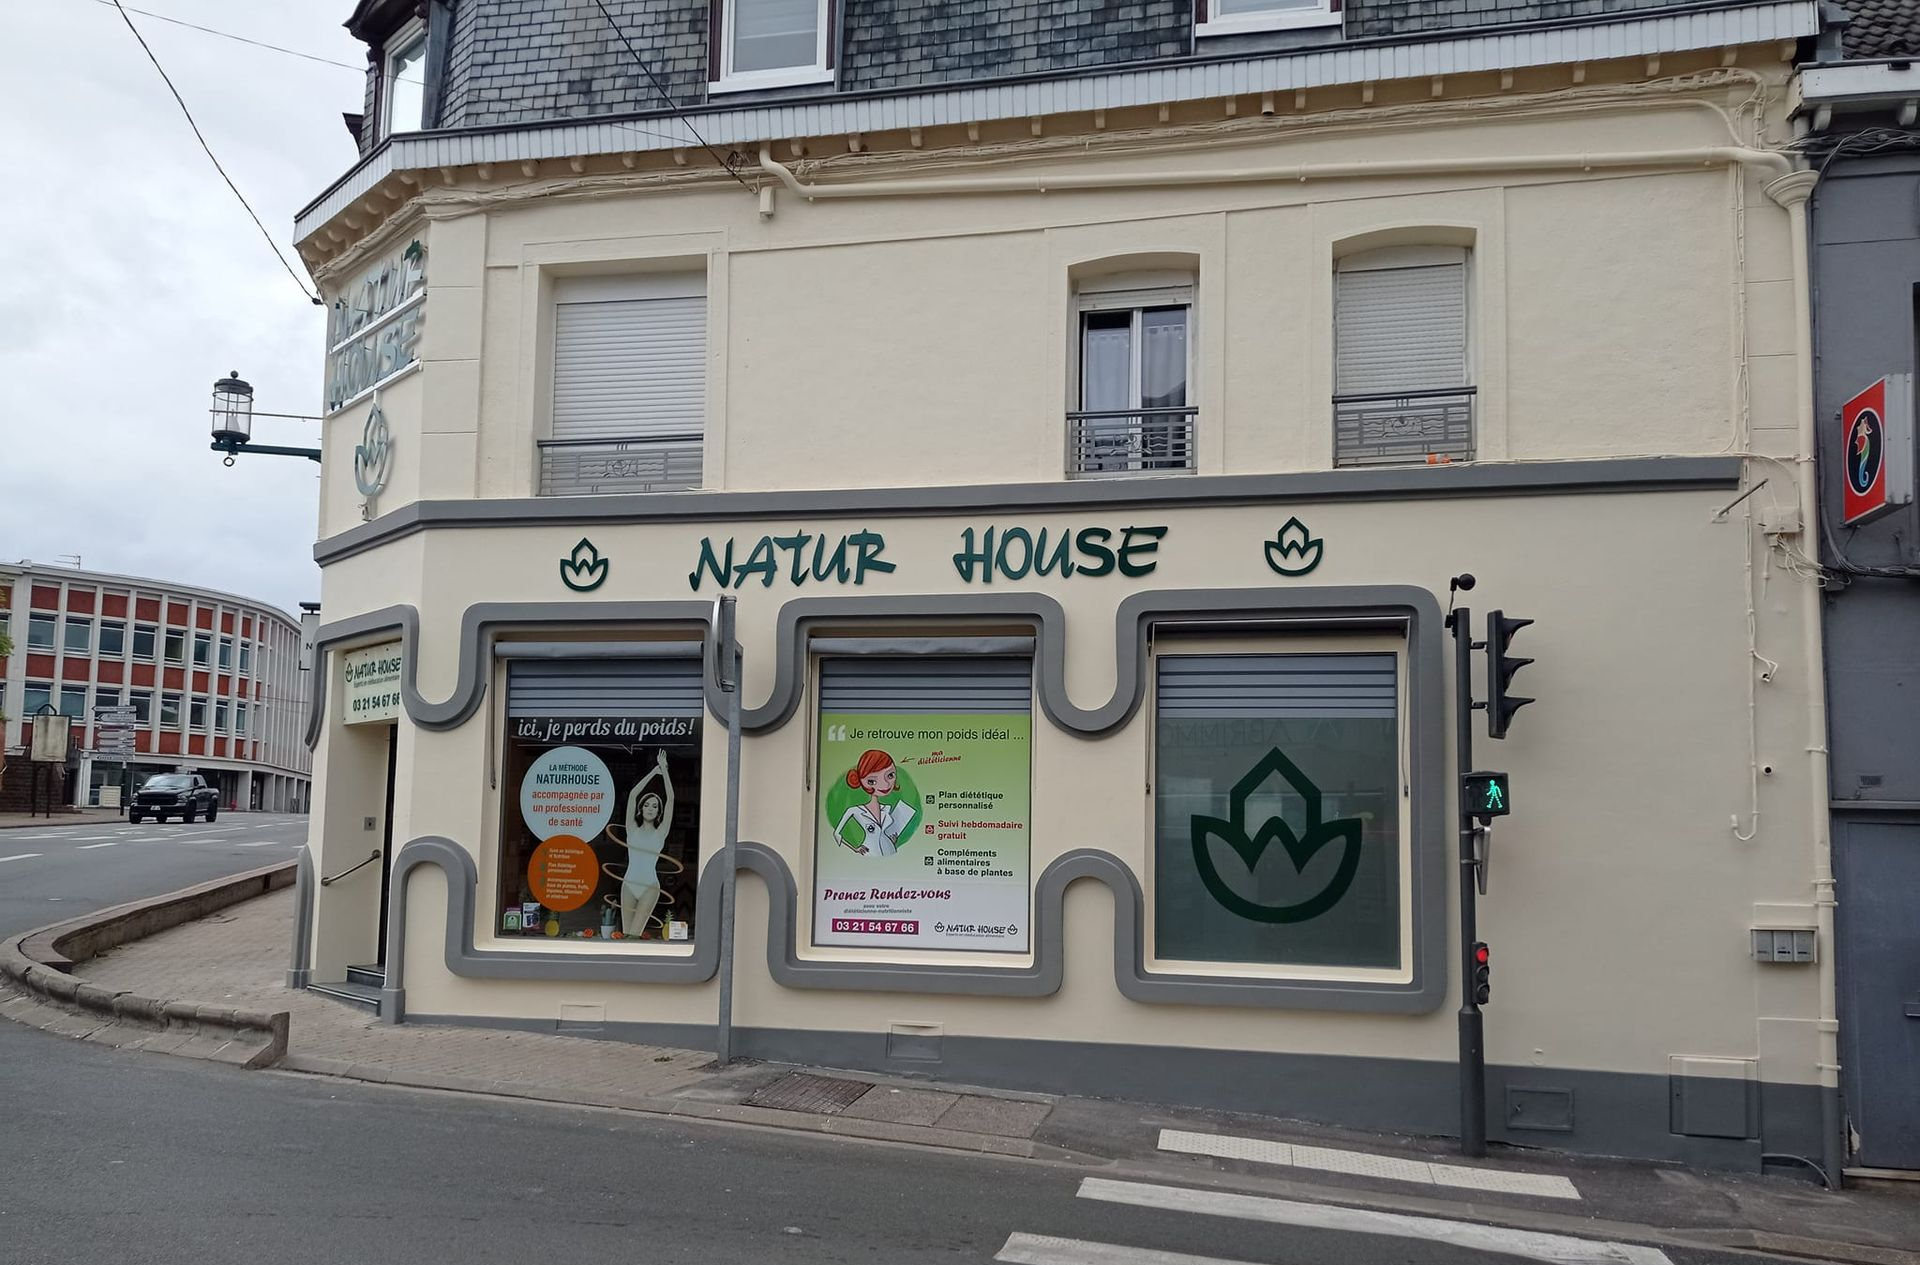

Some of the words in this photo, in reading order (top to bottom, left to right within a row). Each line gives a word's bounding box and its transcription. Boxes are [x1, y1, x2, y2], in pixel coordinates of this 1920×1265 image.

[689, 528, 896, 591] NATUR
[952, 526, 1168, 584] HOUSE
[354, 661, 376, 680] NATUR
[353, 699, 361, 711] 03
[362, 697, 370, 711] 21
[372, 695, 380, 709] 54
[382, 694, 390, 707] 67
[518, 719, 542, 738] ici,
[543, 719, 561, 741] je
[563, 719, 610, 741] perds
[614, 718, 637, 736] du
[850, 728, 864, 739] Je
[867, 729, 914, 740] retrouve
[918, 731, 943, 740] mon
[947, 728, 978, 742] poids
[981, 729, 1010, 740] idéal
[549, 764, 558, 772] LA
[559, 763, 588, 772] MÉTHODE
[536, 774, 600, 785] NATURHOUSE
[532, 790, 590, 801] accompagnée
[590, 792, 605, 802] par
[938, 791, 958, 799] Plan
[959, 791, 1004, 801] diététique
[545, 804, 600, 814] professionnel
[938, 801, 994, 810] personnalisé
[548, 817, 559, 826] de
[560, 817, 583, 827] santé
[938, 820, 960, 829] Suivi
[961, 821, 1023, 830] hebdomadaire
[937, 831, 967, 841] gratuit
[937, 849, 997, 859] Compléments
[937, 858, 991, 867] alimentaires
[937, 867, 942, 875] à
[945, 868, 966, 876] base
[968, 868, 979, 876] de
[981, 869, 1013, 878] plantes
[824, 889, 866, 901] Prenez
[870, 887, 952, 900] Rendez-vous
[836, 921, 849, 931] 03
[852, 922, 865, 932] 21
[868, 922, 882, 932] 54
[884, 922, 898, 932] 67
[901, 923, 914, 933] 66
[946, 924, 976, 933] NATUR
[977, 925, 1006, 935] HOUSE
